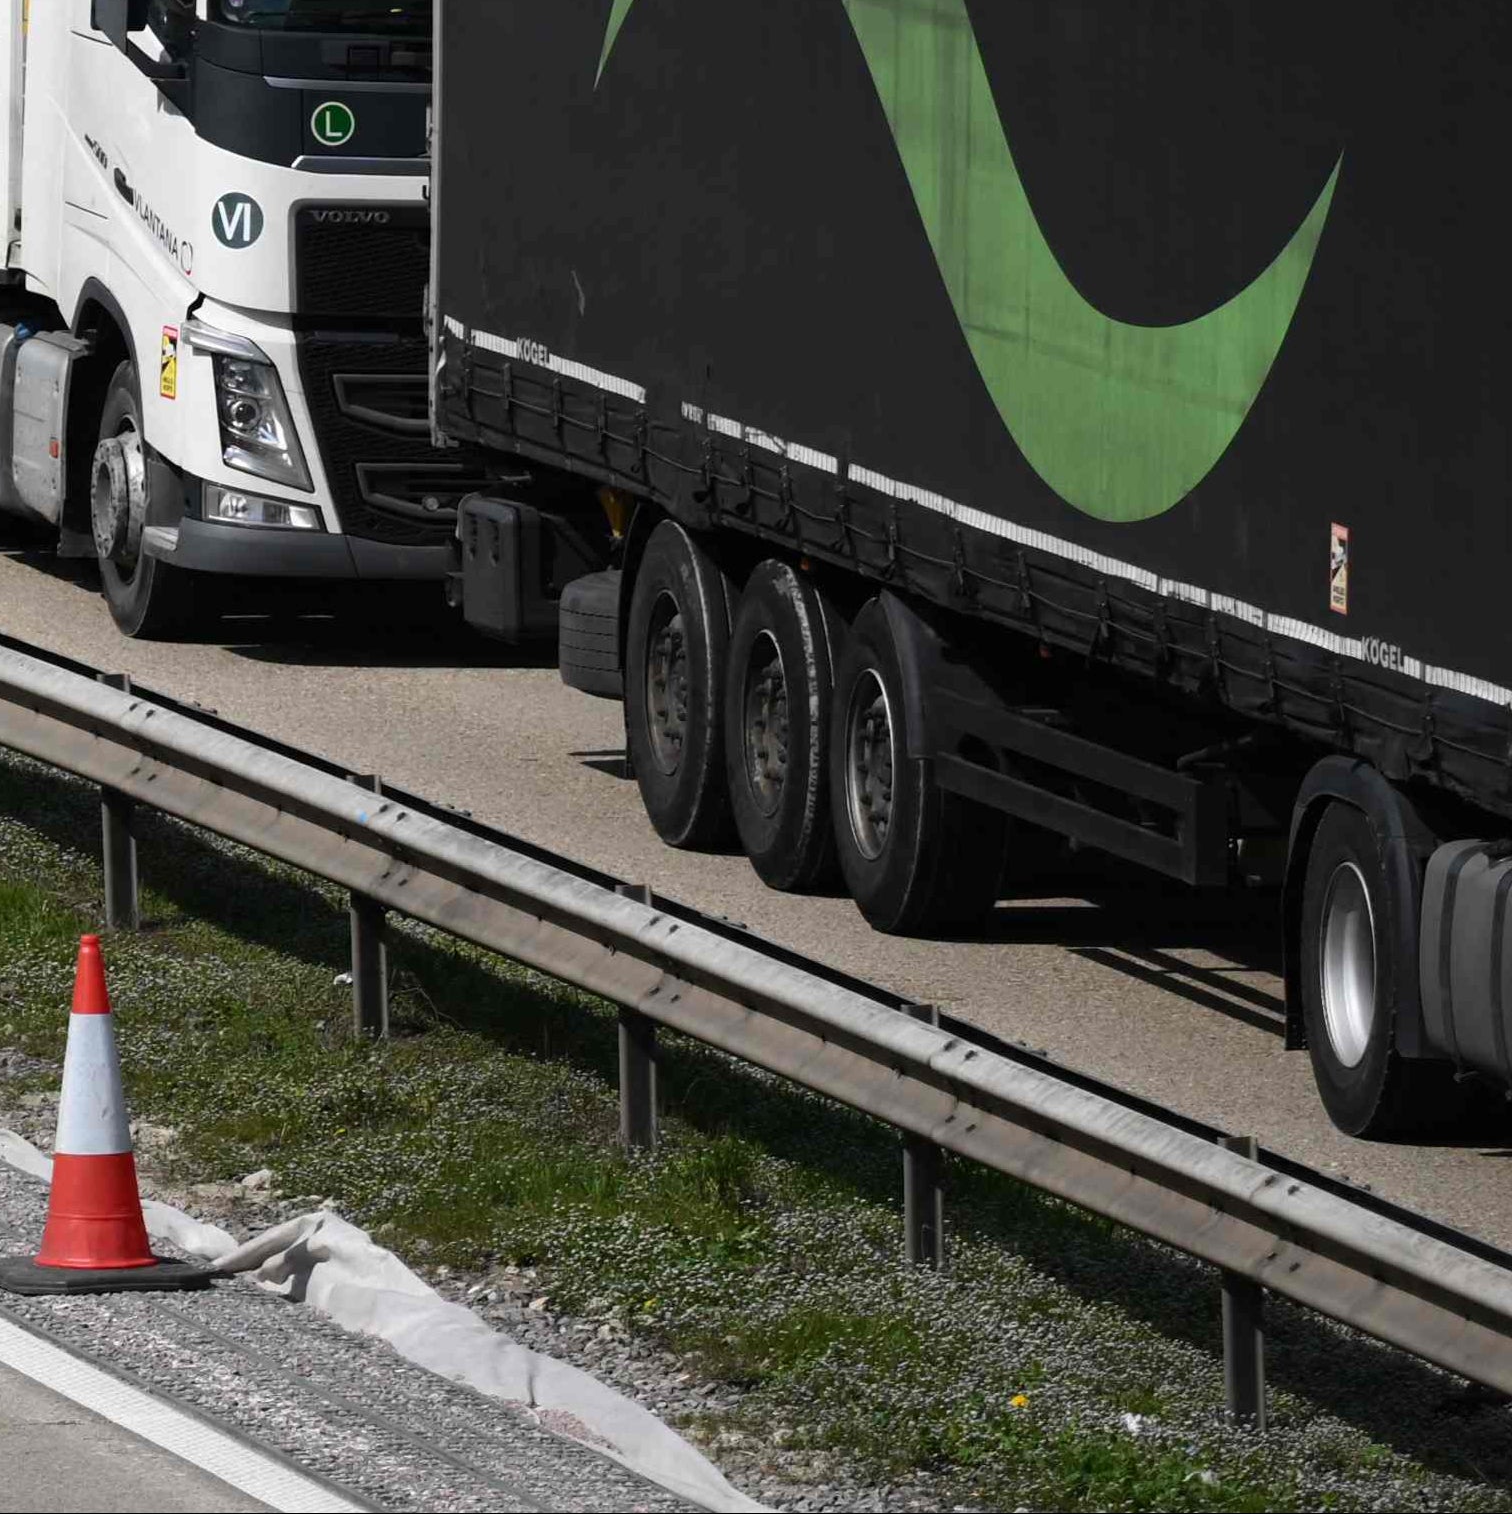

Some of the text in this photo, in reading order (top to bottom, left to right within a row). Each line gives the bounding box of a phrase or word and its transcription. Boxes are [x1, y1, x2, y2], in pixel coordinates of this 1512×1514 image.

[325, 111, 342, 137] L
[133, 189, 179, 261] VLANTANA
[217, 201, 252, 242] VI
[310, 209, 391, 224] VOLVO
[516, 336, 551, 367] KÖGEL
[1361, 636, 1406, 674] KÖGEL
